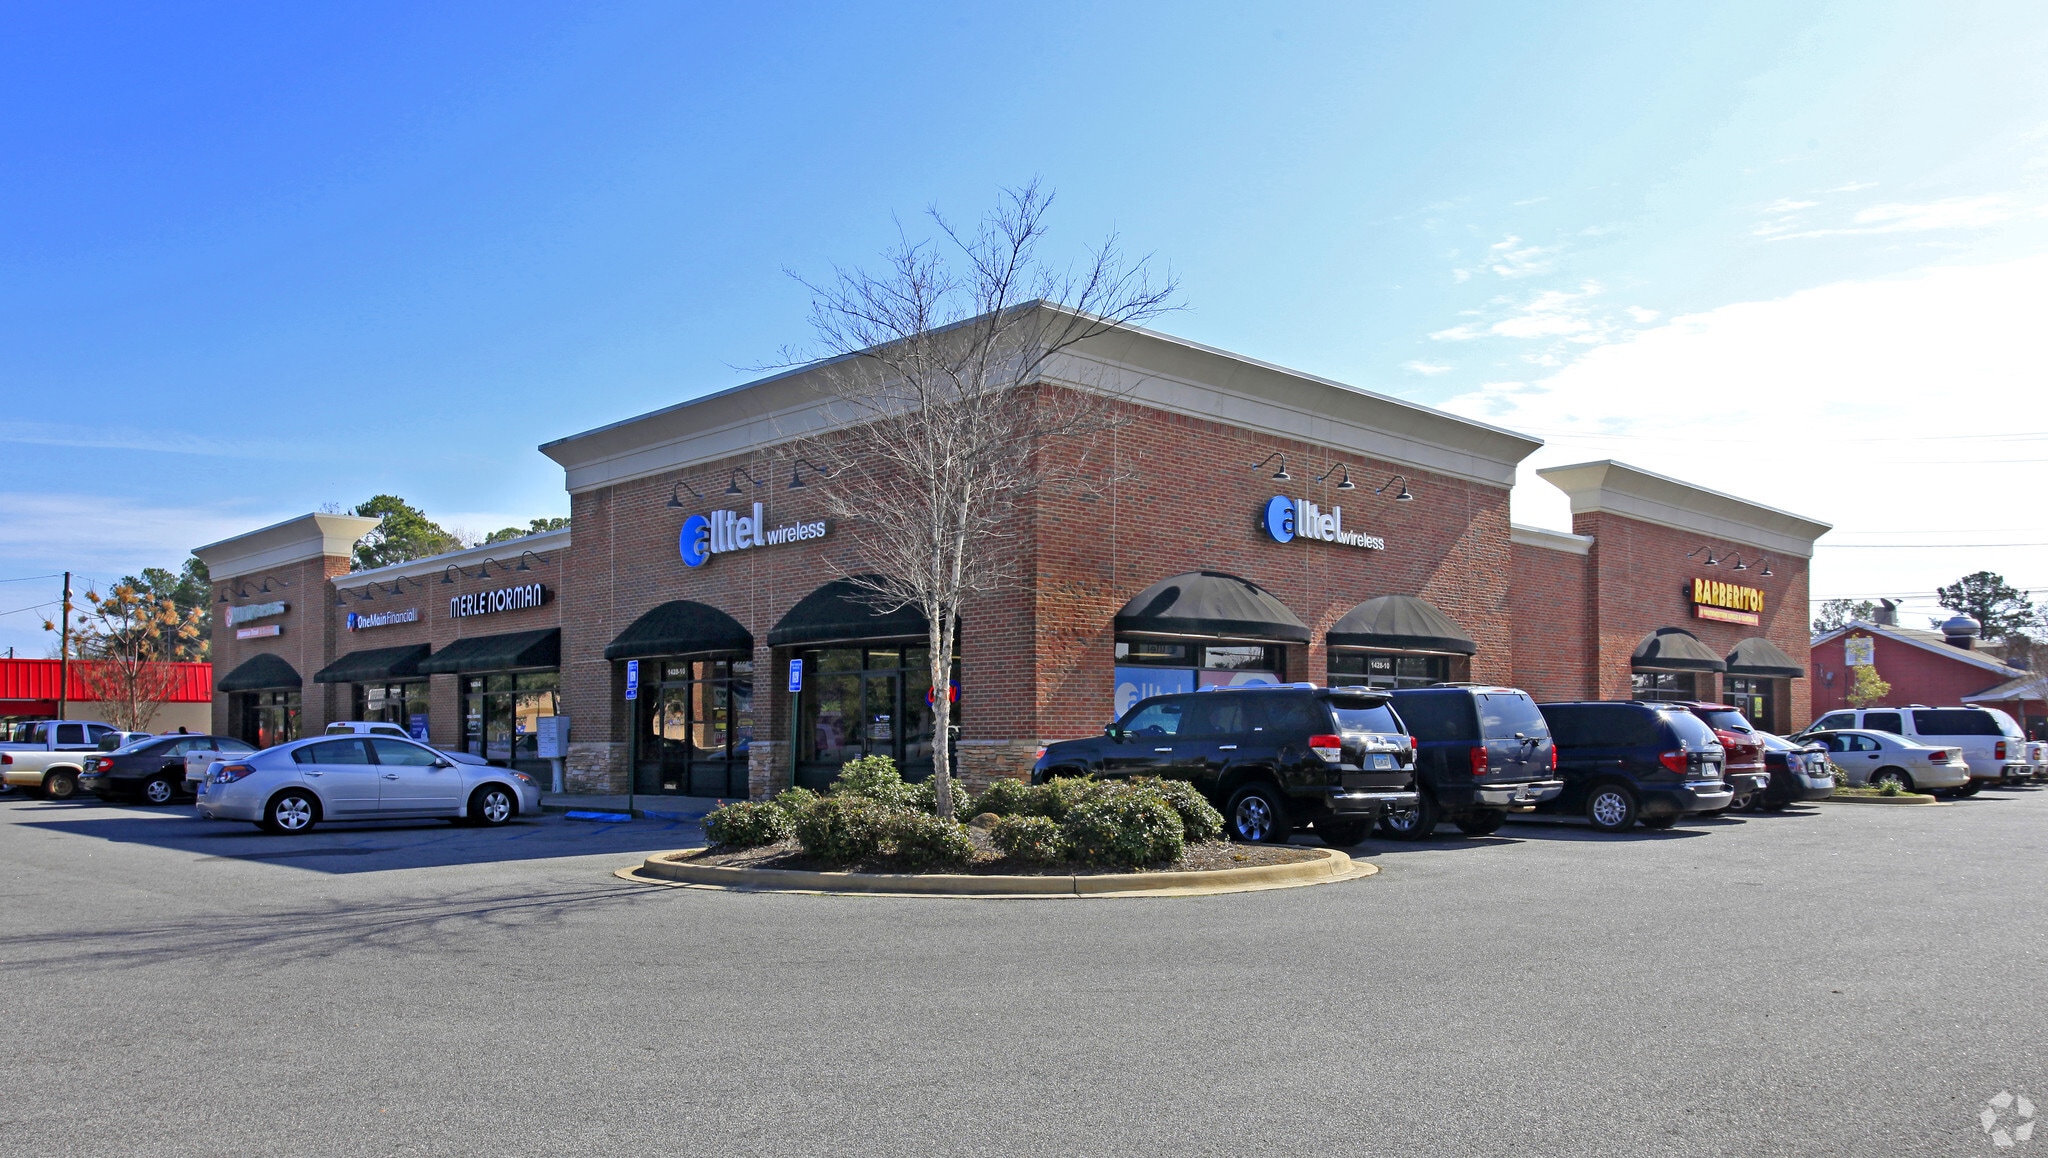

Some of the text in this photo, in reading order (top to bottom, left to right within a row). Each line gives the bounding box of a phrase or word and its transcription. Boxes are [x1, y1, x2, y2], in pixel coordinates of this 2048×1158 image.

[680, 502, 826, 567] alltel wireless
[1264, 495, 1385, 550] alltel wireless
[450, 583, 542, 618] MERLE NORMAN
[1694, 577, 1765, 612] BARBERITOS
[1114, 682, 1182, 718] allt
